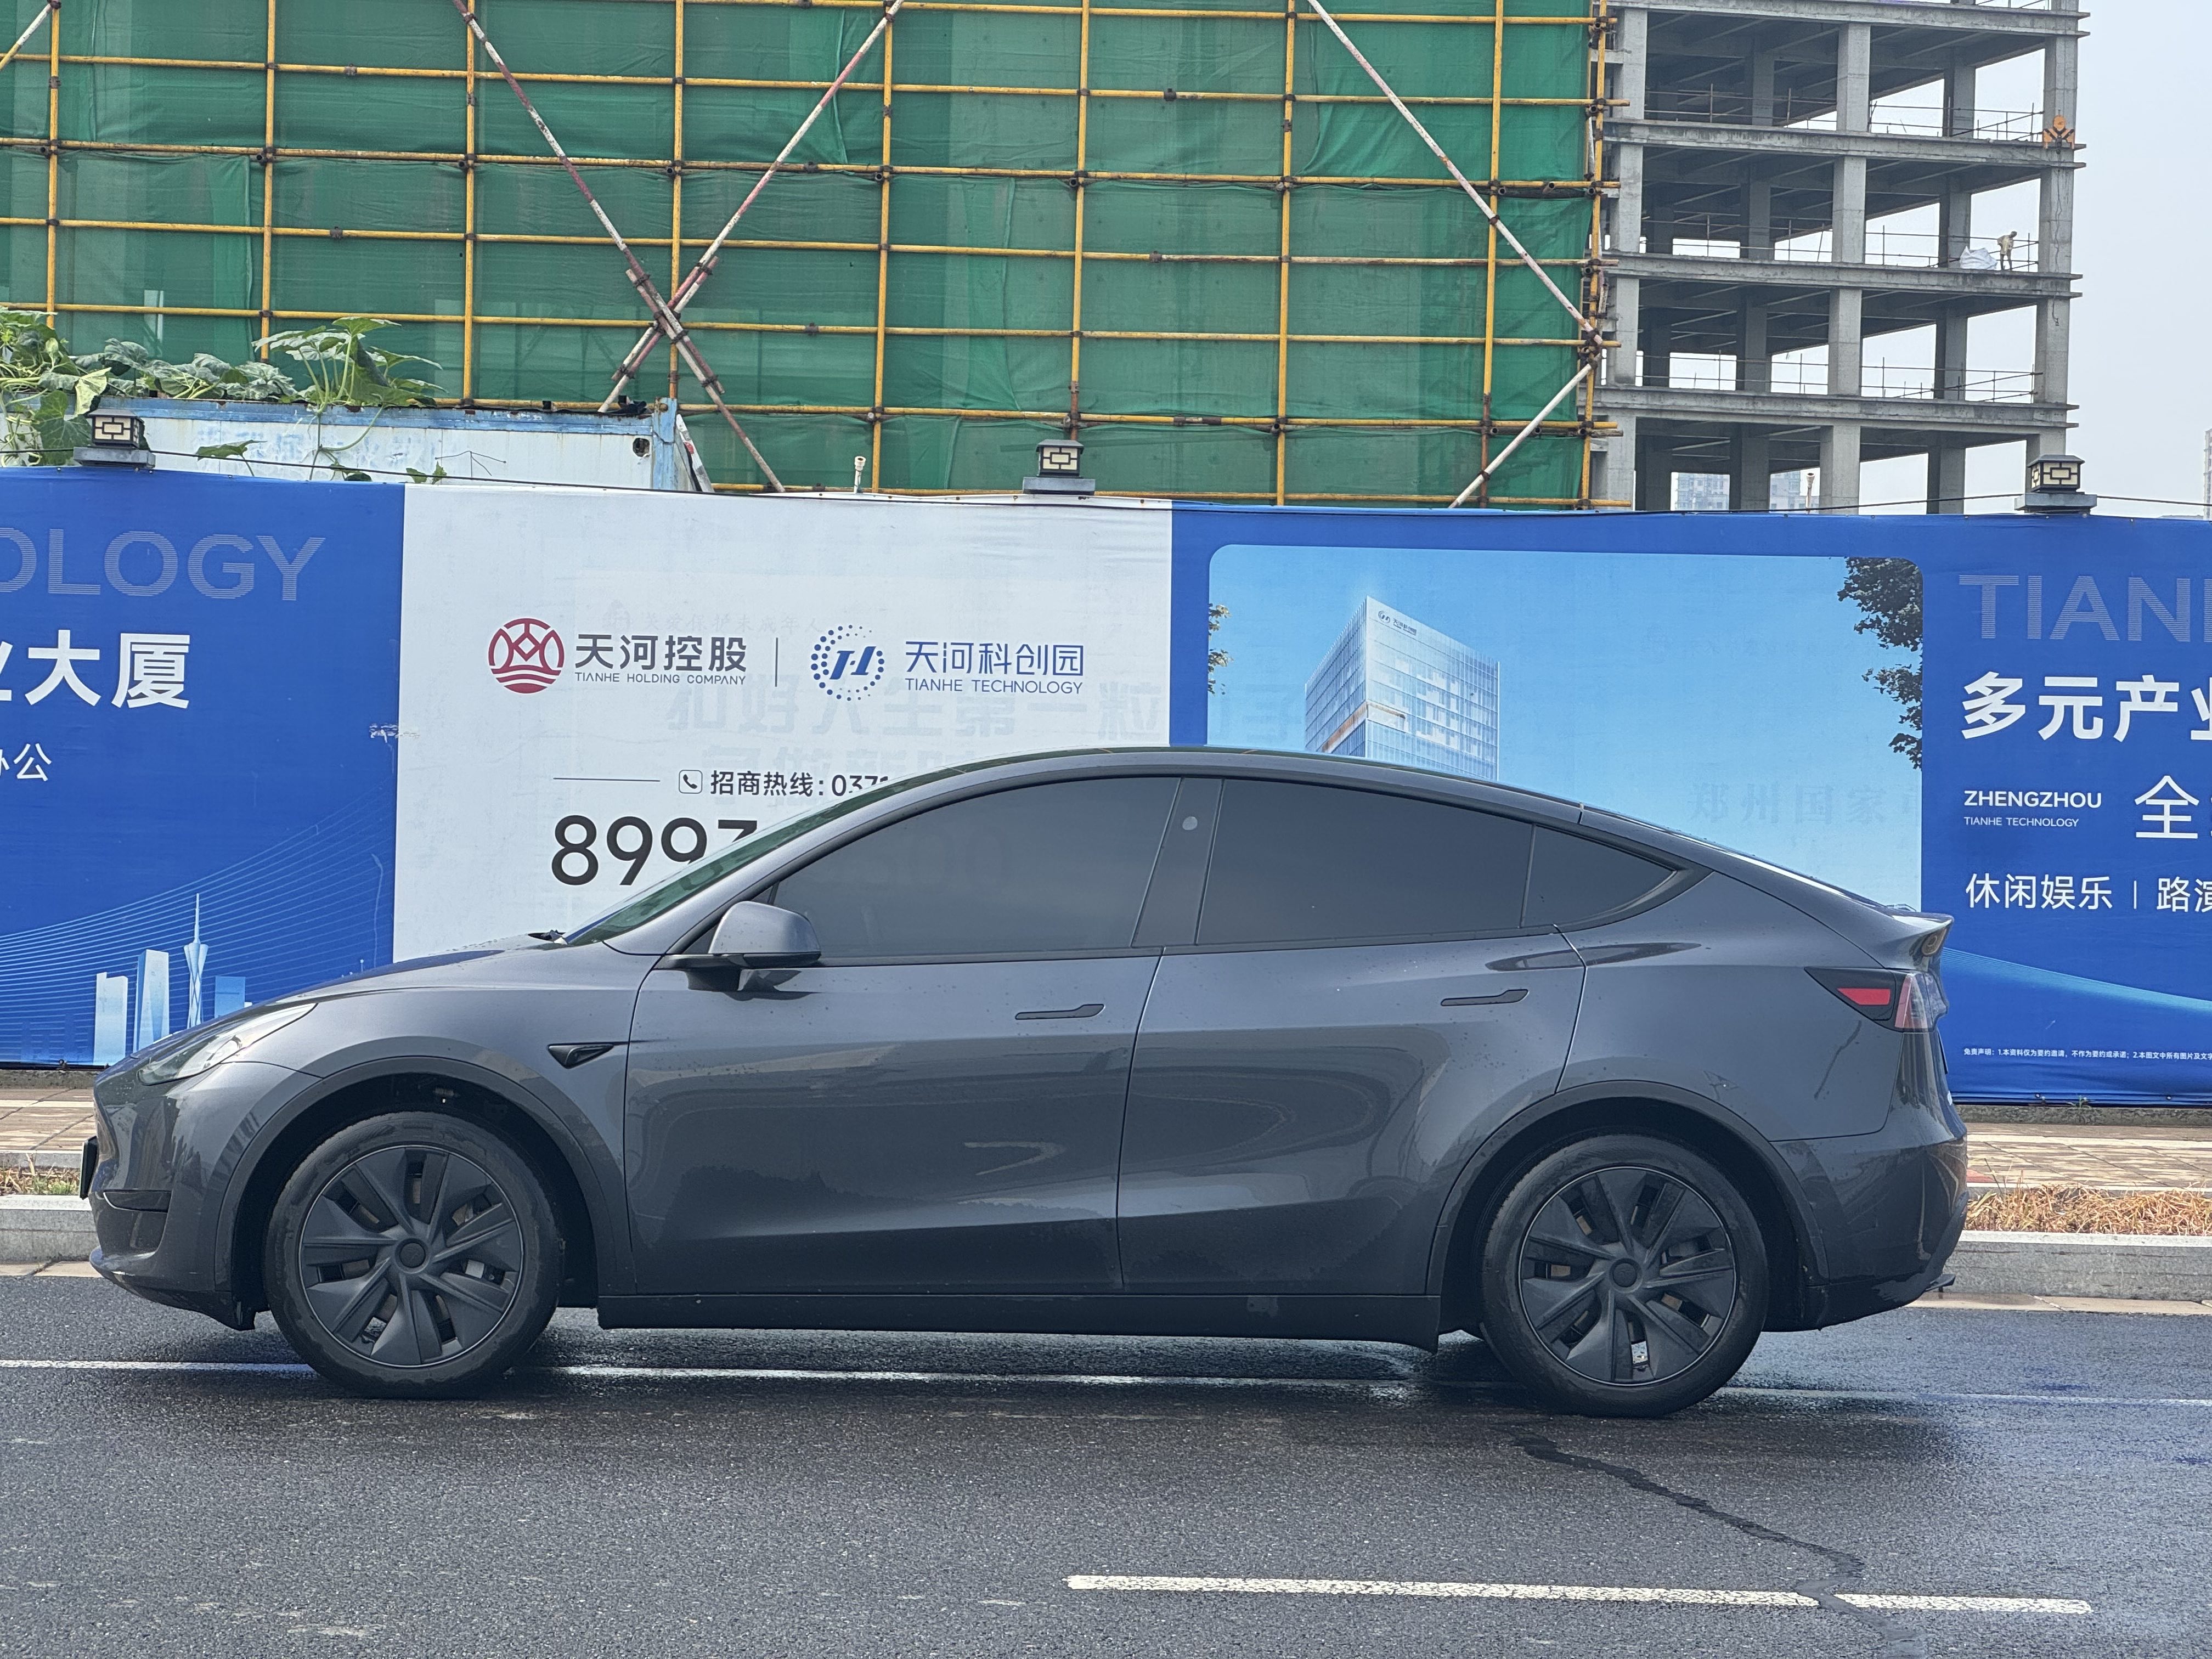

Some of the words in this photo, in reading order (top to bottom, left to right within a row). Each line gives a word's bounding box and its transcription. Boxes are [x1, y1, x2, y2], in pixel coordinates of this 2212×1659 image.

[0, 629, 191, 709] 大厦
[575, 634, 747, 673] 天河控股
[905, 641, 1084, 676] 天河科创园
[574, 672, 620, 682] TIANHE
[627, 673, 680, 684] HOLDING
[686, 674, 746, 685] COMPANY
[905, 678, 963, 692] TIANHE
[971, 679, 1083, 695] TECHNOLOGY
[0, 743, 52, 782] 公
[1964, 790, 2102, 808] ZHENGZHOU
[1963, 816, 2002, 826] TIANHE
[2006, 817, 2079, 827] TECHNOLOGY
[1965, 873, 2113, 910] 休闲娱乐
